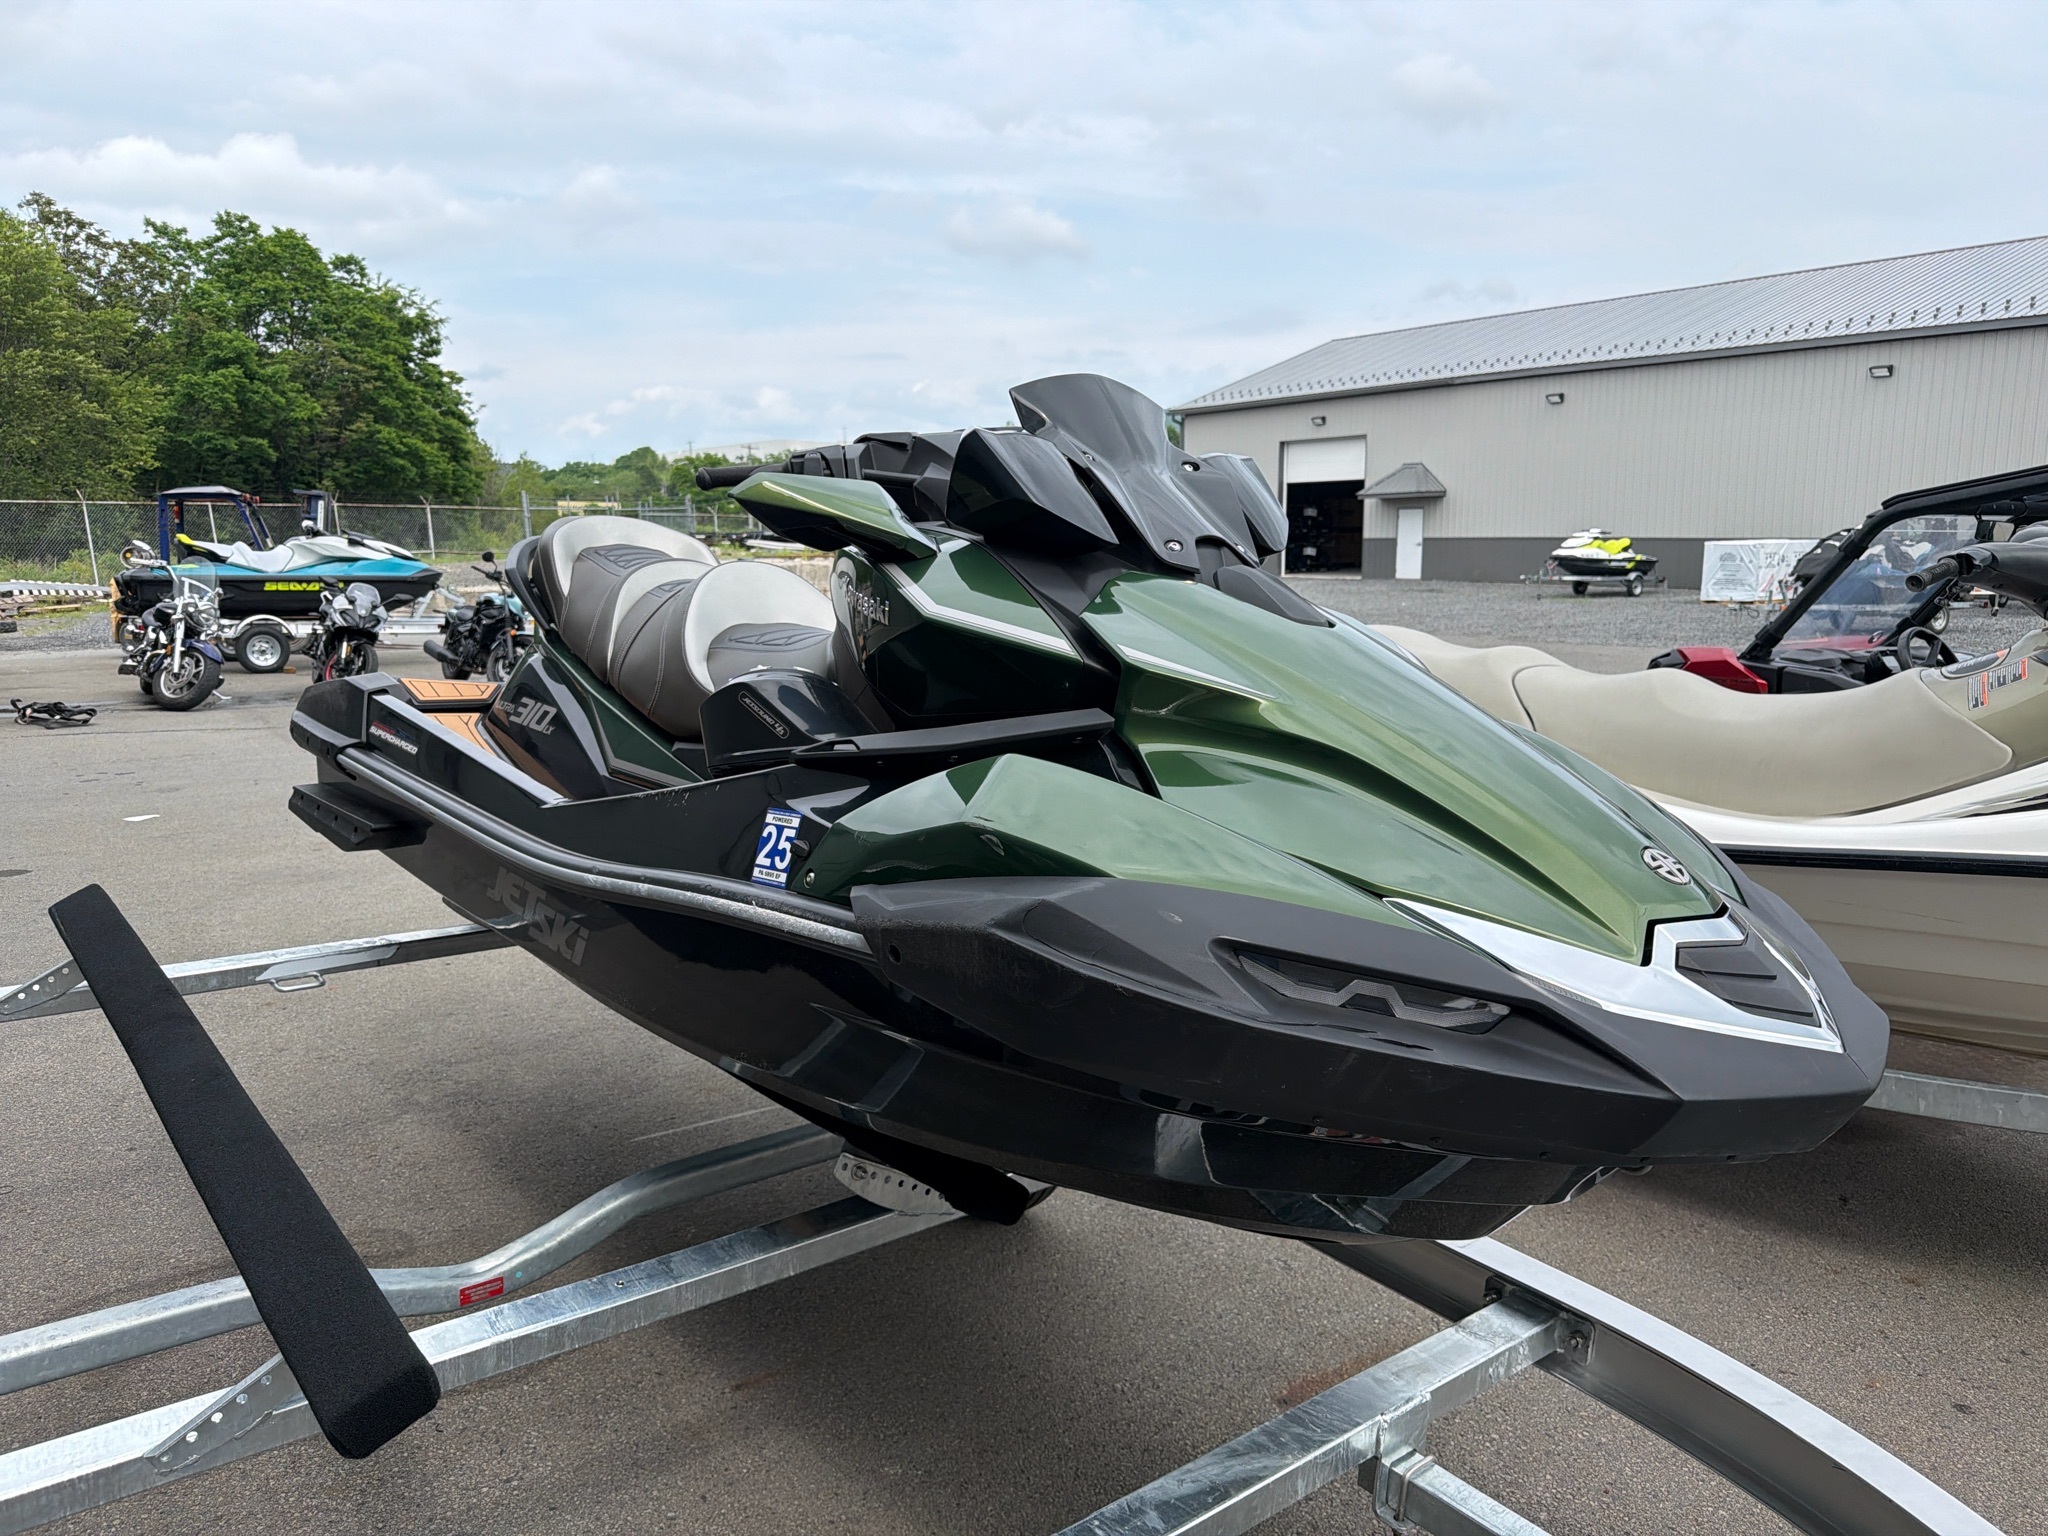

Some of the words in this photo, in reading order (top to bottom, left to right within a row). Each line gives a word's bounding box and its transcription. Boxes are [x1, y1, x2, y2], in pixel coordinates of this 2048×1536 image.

[509, 696, 557, 732] 310
[742, 697, 775, 725] JETSOUND
[369, 725, 418, 755] SUPERCHARGED
[771, 815, 793, 825] POWERED
[755, 824, 797, 870] 25
